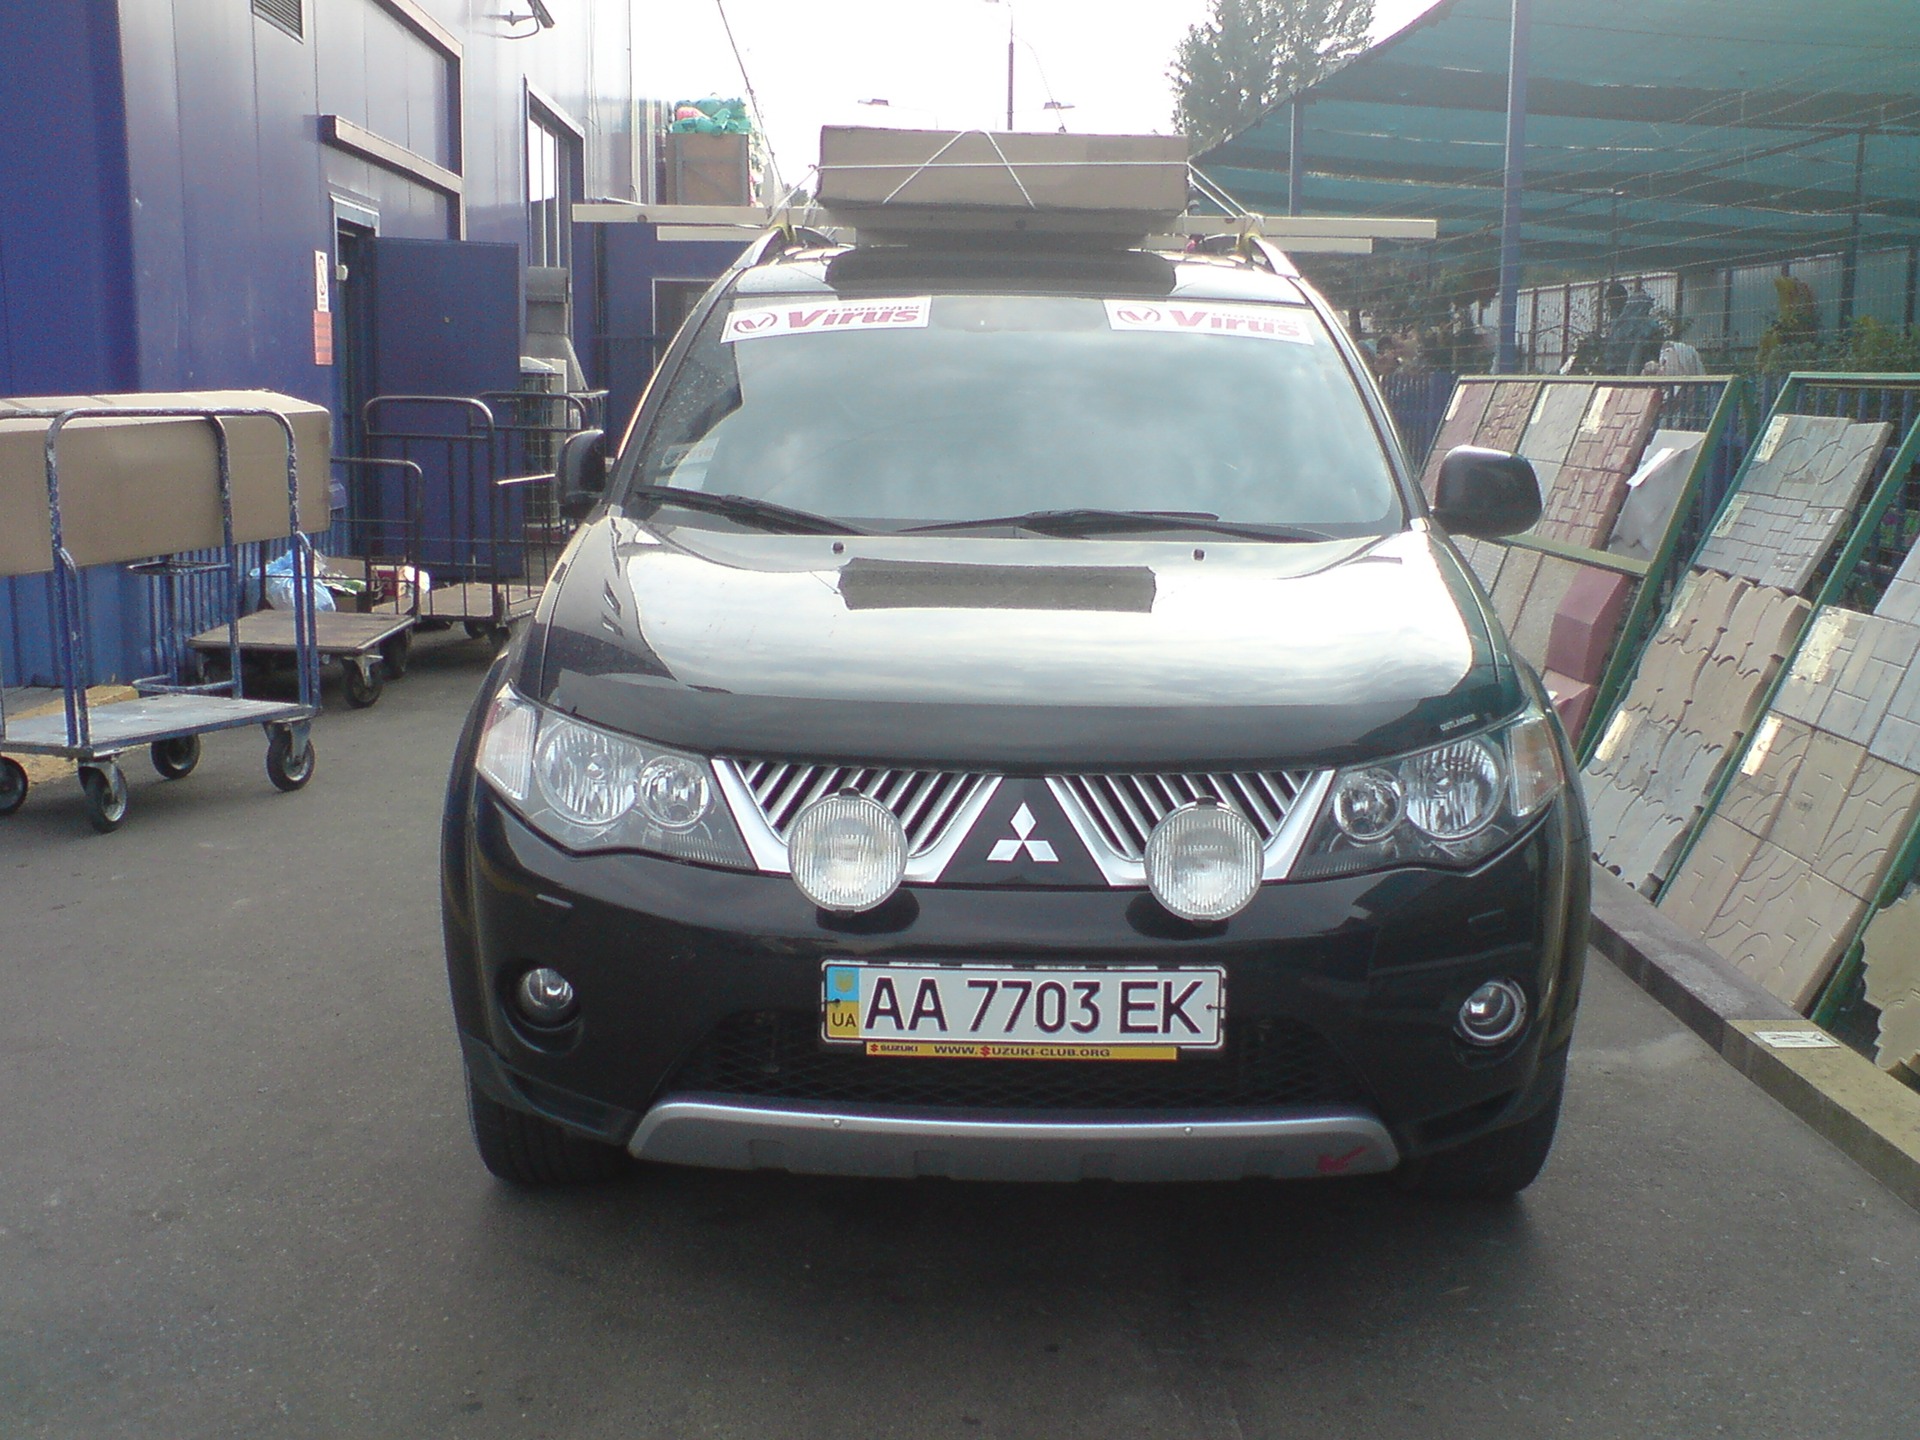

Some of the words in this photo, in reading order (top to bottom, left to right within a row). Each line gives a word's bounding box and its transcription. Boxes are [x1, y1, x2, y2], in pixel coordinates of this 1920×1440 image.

[788, 309, 919, 329] Virus
[1169, 310, 1301, 337] Virus
[864, 977, 949, 1032] AA
[966, 979, 1101, 1034] 7703
[1119, 980, 1204, 1034] EK
[831, 1012, 857, 1028] UA
[880, 1044, 918, 1052] SUZUKI
